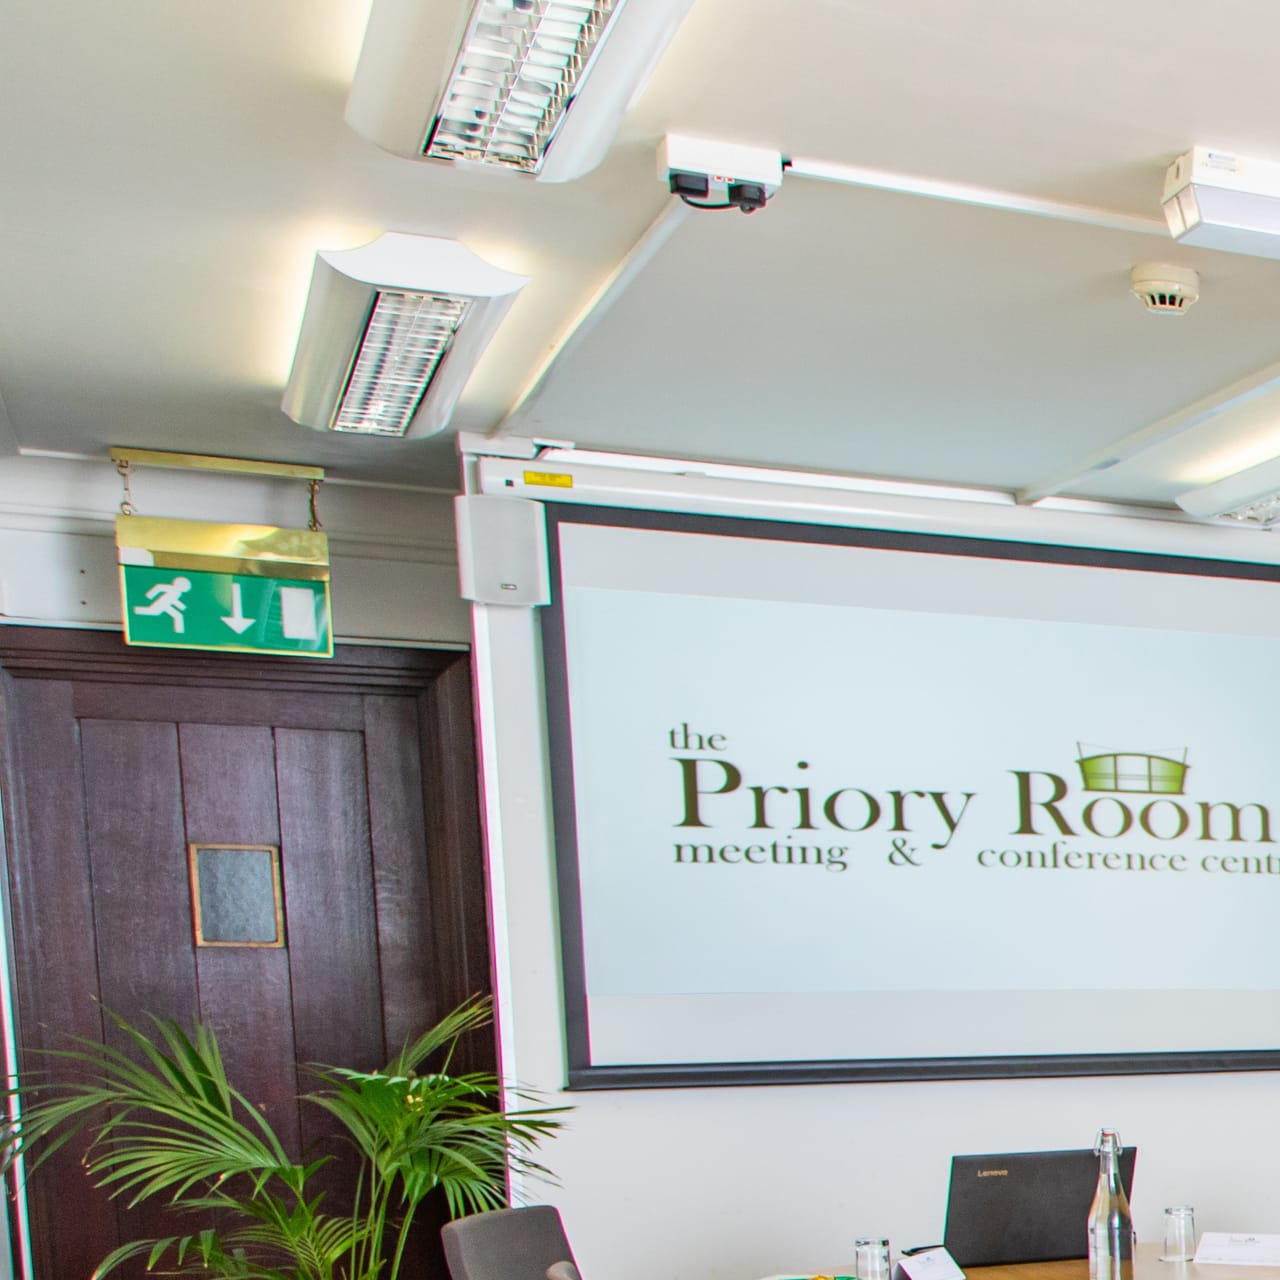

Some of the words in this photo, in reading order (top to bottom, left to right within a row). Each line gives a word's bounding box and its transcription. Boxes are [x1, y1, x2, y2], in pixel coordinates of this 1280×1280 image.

[669, 722, 728, 751] the
[670, 757, 977, 850] Priory
[673, 835, 849, 873] meeting
[887, 837, 924, 867] &
[977, 841, 1188, 873] conference
